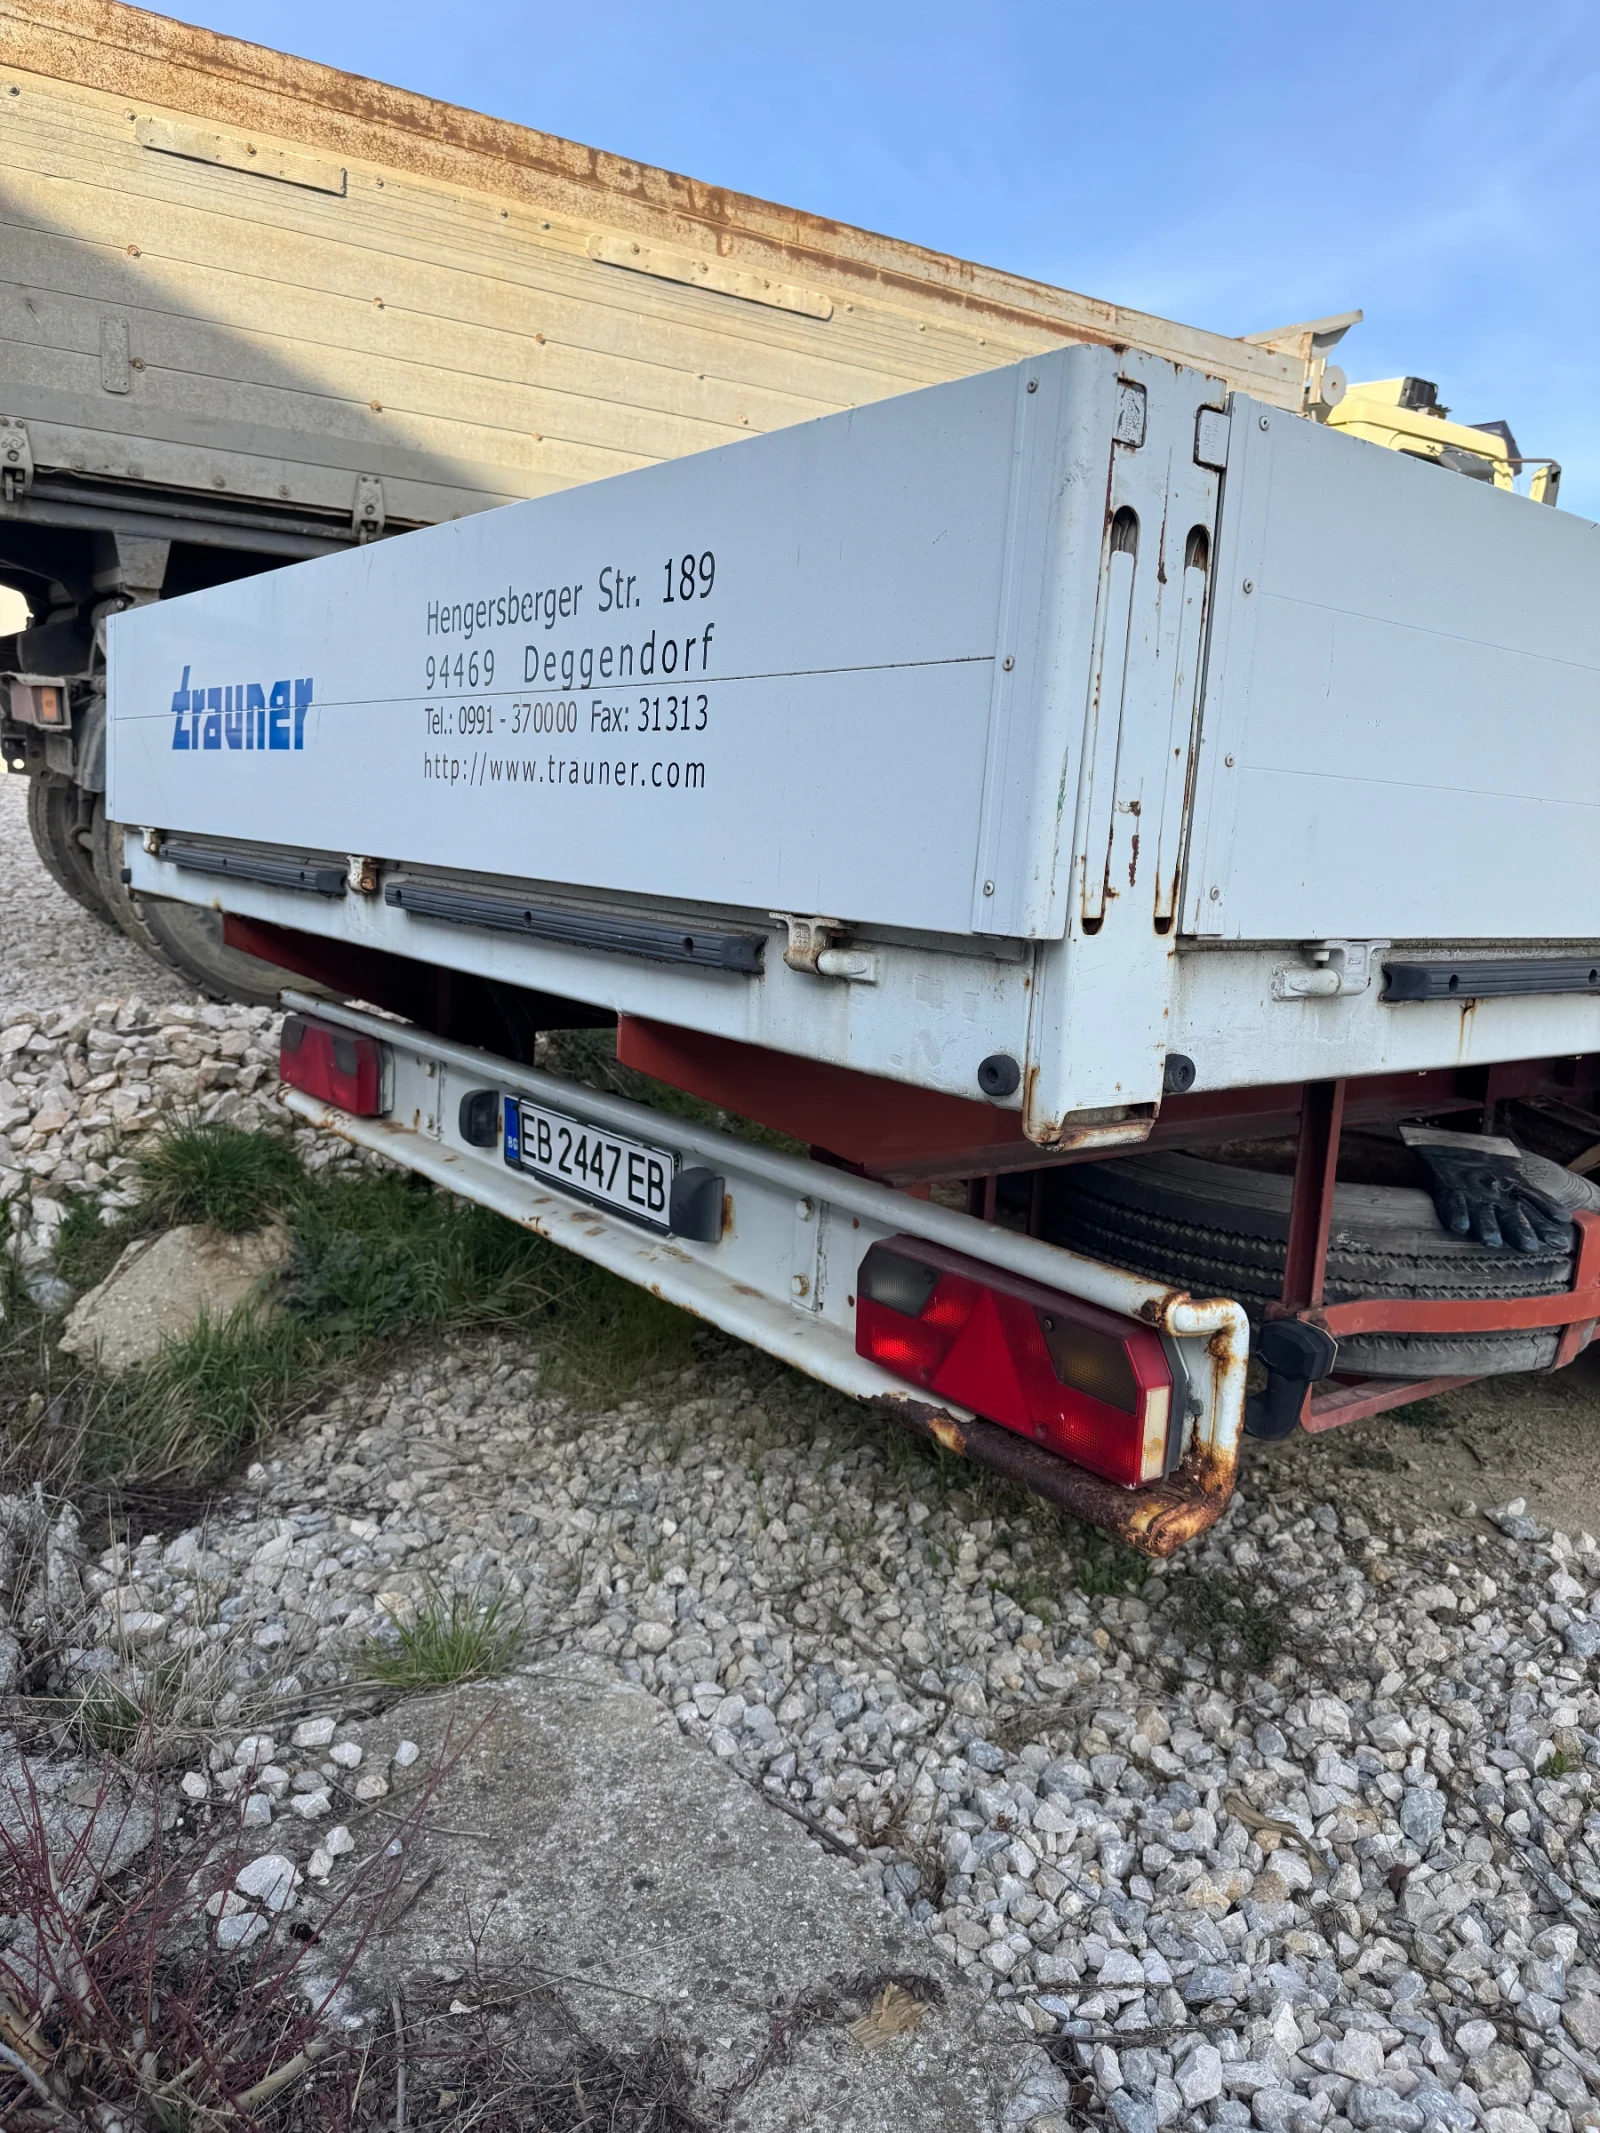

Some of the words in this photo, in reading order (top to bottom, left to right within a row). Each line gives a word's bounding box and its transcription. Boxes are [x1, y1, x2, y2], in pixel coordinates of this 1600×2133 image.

[427, 584, 583, 640] Hengersberger
[598, 566, 640, 612] Str.
[663, 551, 716, 603] 189
[425, 649, 495, 690] 94469
[524, 623, 715, 690] Deggendorf
[171, 665, 313, 750] trauner
[425, 707, 453, 735] Tel.:
[511, 701, 578, 734] 370000
[590, 700, 629, 732] Fax:
[637, 694, 709, 732] 31313
[424, 751, 706, 789] http://www.trauner.com
[507, 1135, 518, 1150] BG
[522, 1112, 553, 1165] EB
[558, 1127, 621, 1192] 2447
[628, 1150, 665, 1213] EB
